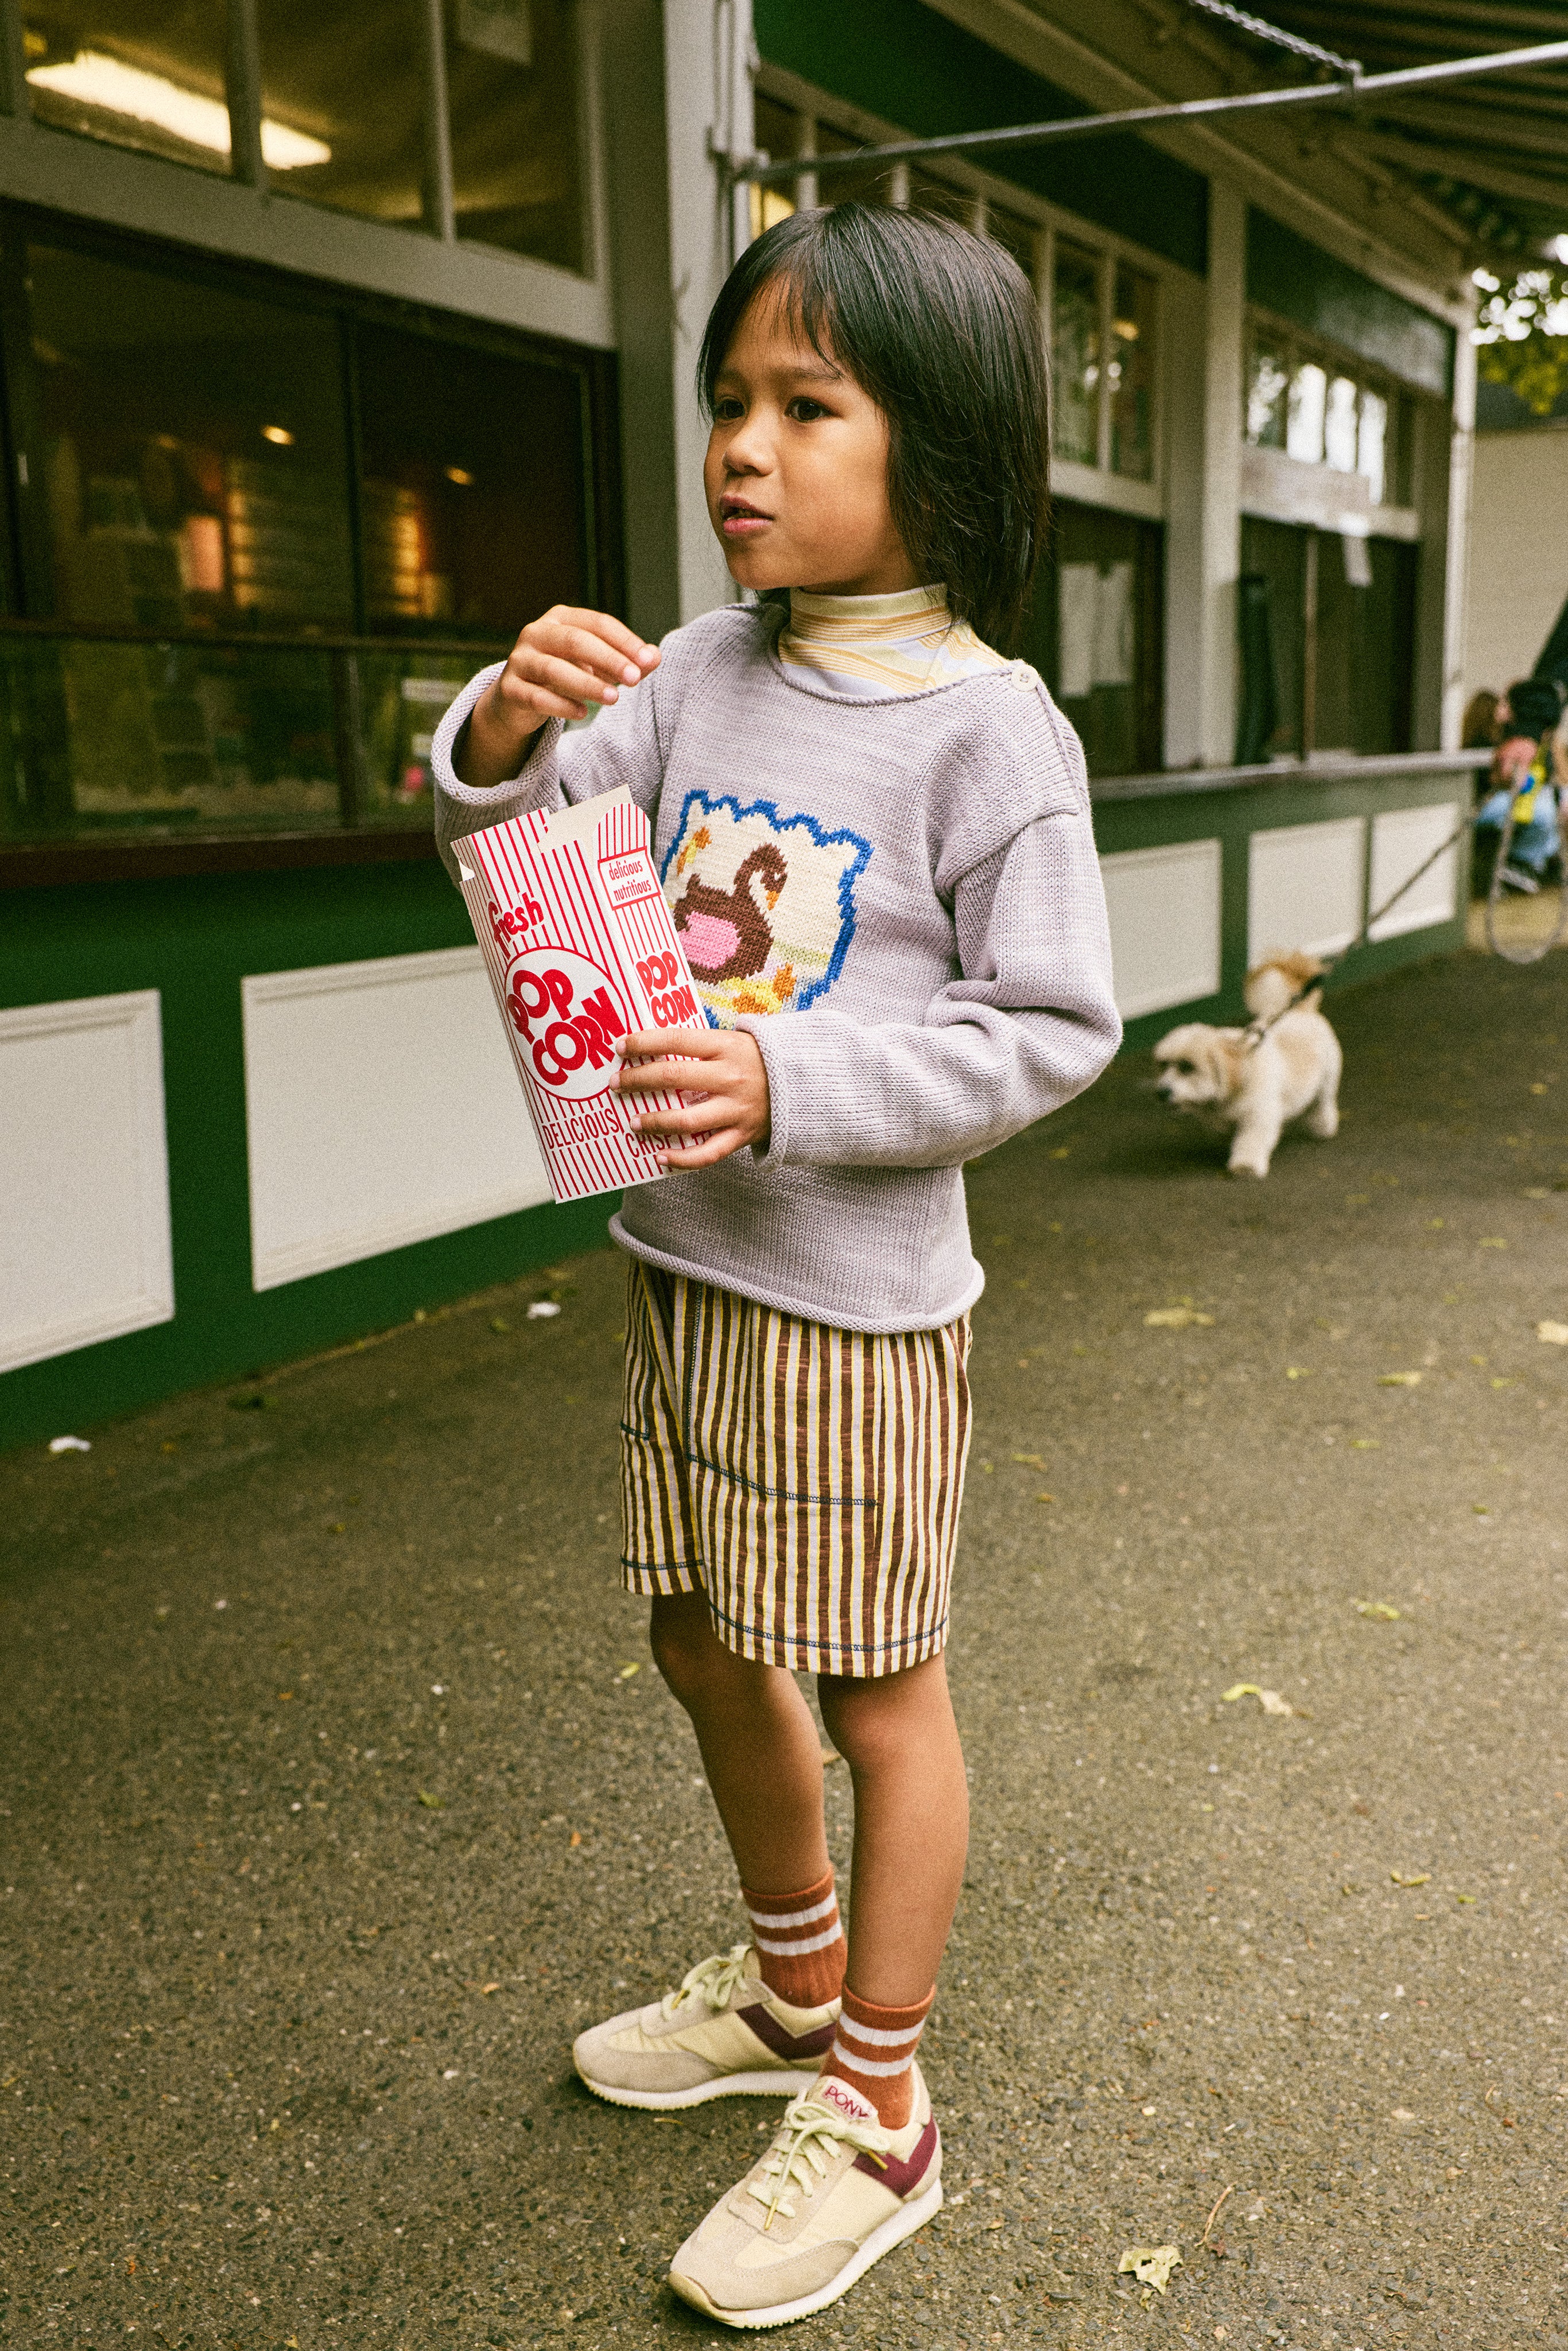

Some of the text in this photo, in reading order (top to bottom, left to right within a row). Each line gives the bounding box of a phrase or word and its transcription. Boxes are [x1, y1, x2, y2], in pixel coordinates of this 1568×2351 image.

[609, 860, 643, 880] delicious
[614, 879, 651, 901] nutritious
[488, 892, 544, 960] fresh
[635, 951, 678, 997] POP
[507, 969, 573, 1045] POP
[651, 984, 698, 1028] CORN
[532, 986, 627, 1086] CORN
[542, 1108, 619, 1149] DELICIOUS
[825, 2085, 868, 2117] PONY
